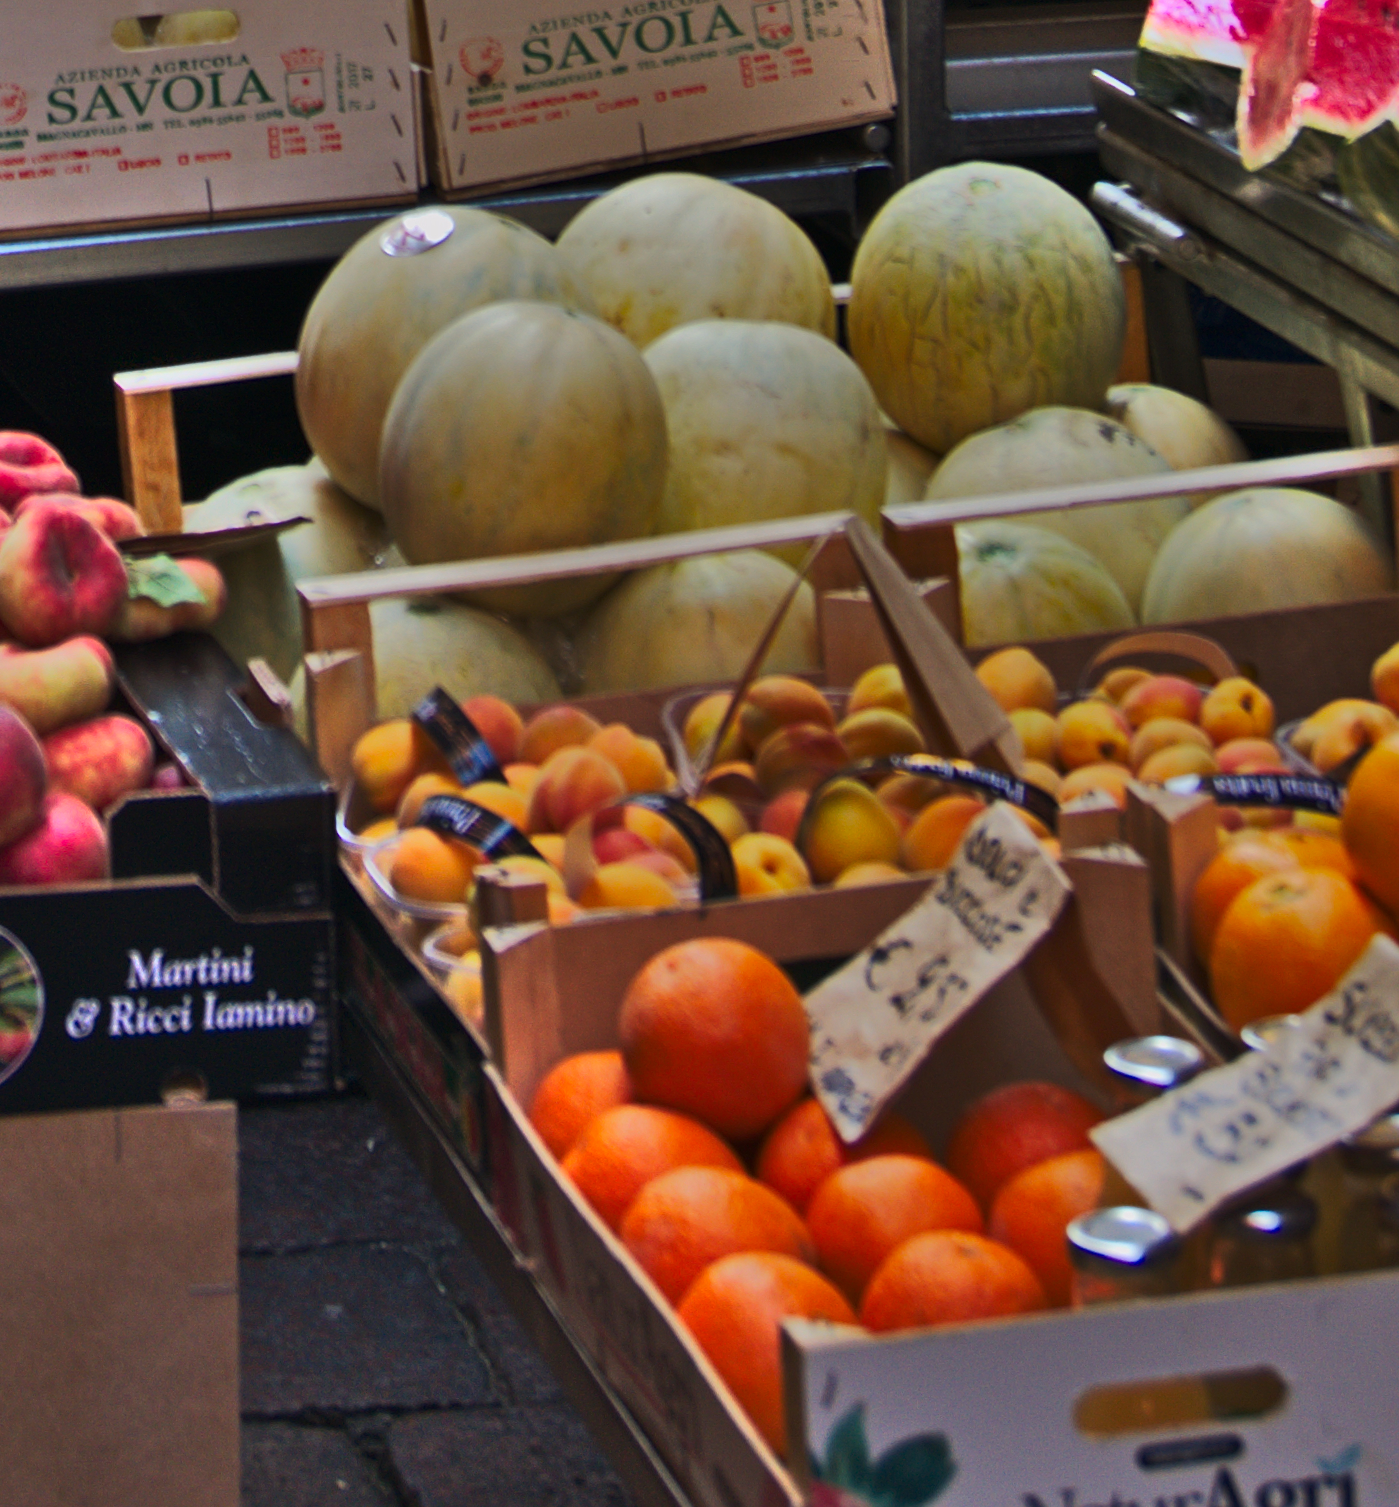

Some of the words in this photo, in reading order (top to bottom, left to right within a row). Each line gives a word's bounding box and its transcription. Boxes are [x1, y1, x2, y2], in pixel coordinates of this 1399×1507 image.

[522, 4, 745, 76] SAVOIA
[529, 10, 612, 35] AZIENDA
[55, 66, 140, 84] AZIENDA
[152, 54, 250, 75] AGRICOLA
[346, 61, 361, 88] 2017
[362, 66, 374, 82] 27
[47, 68, 275, 125] SAVOIA
[126, 944, 254, 990] Martini
[65, 998, 101, 1039] &
[109, 994, 192, 1036] Ricci
